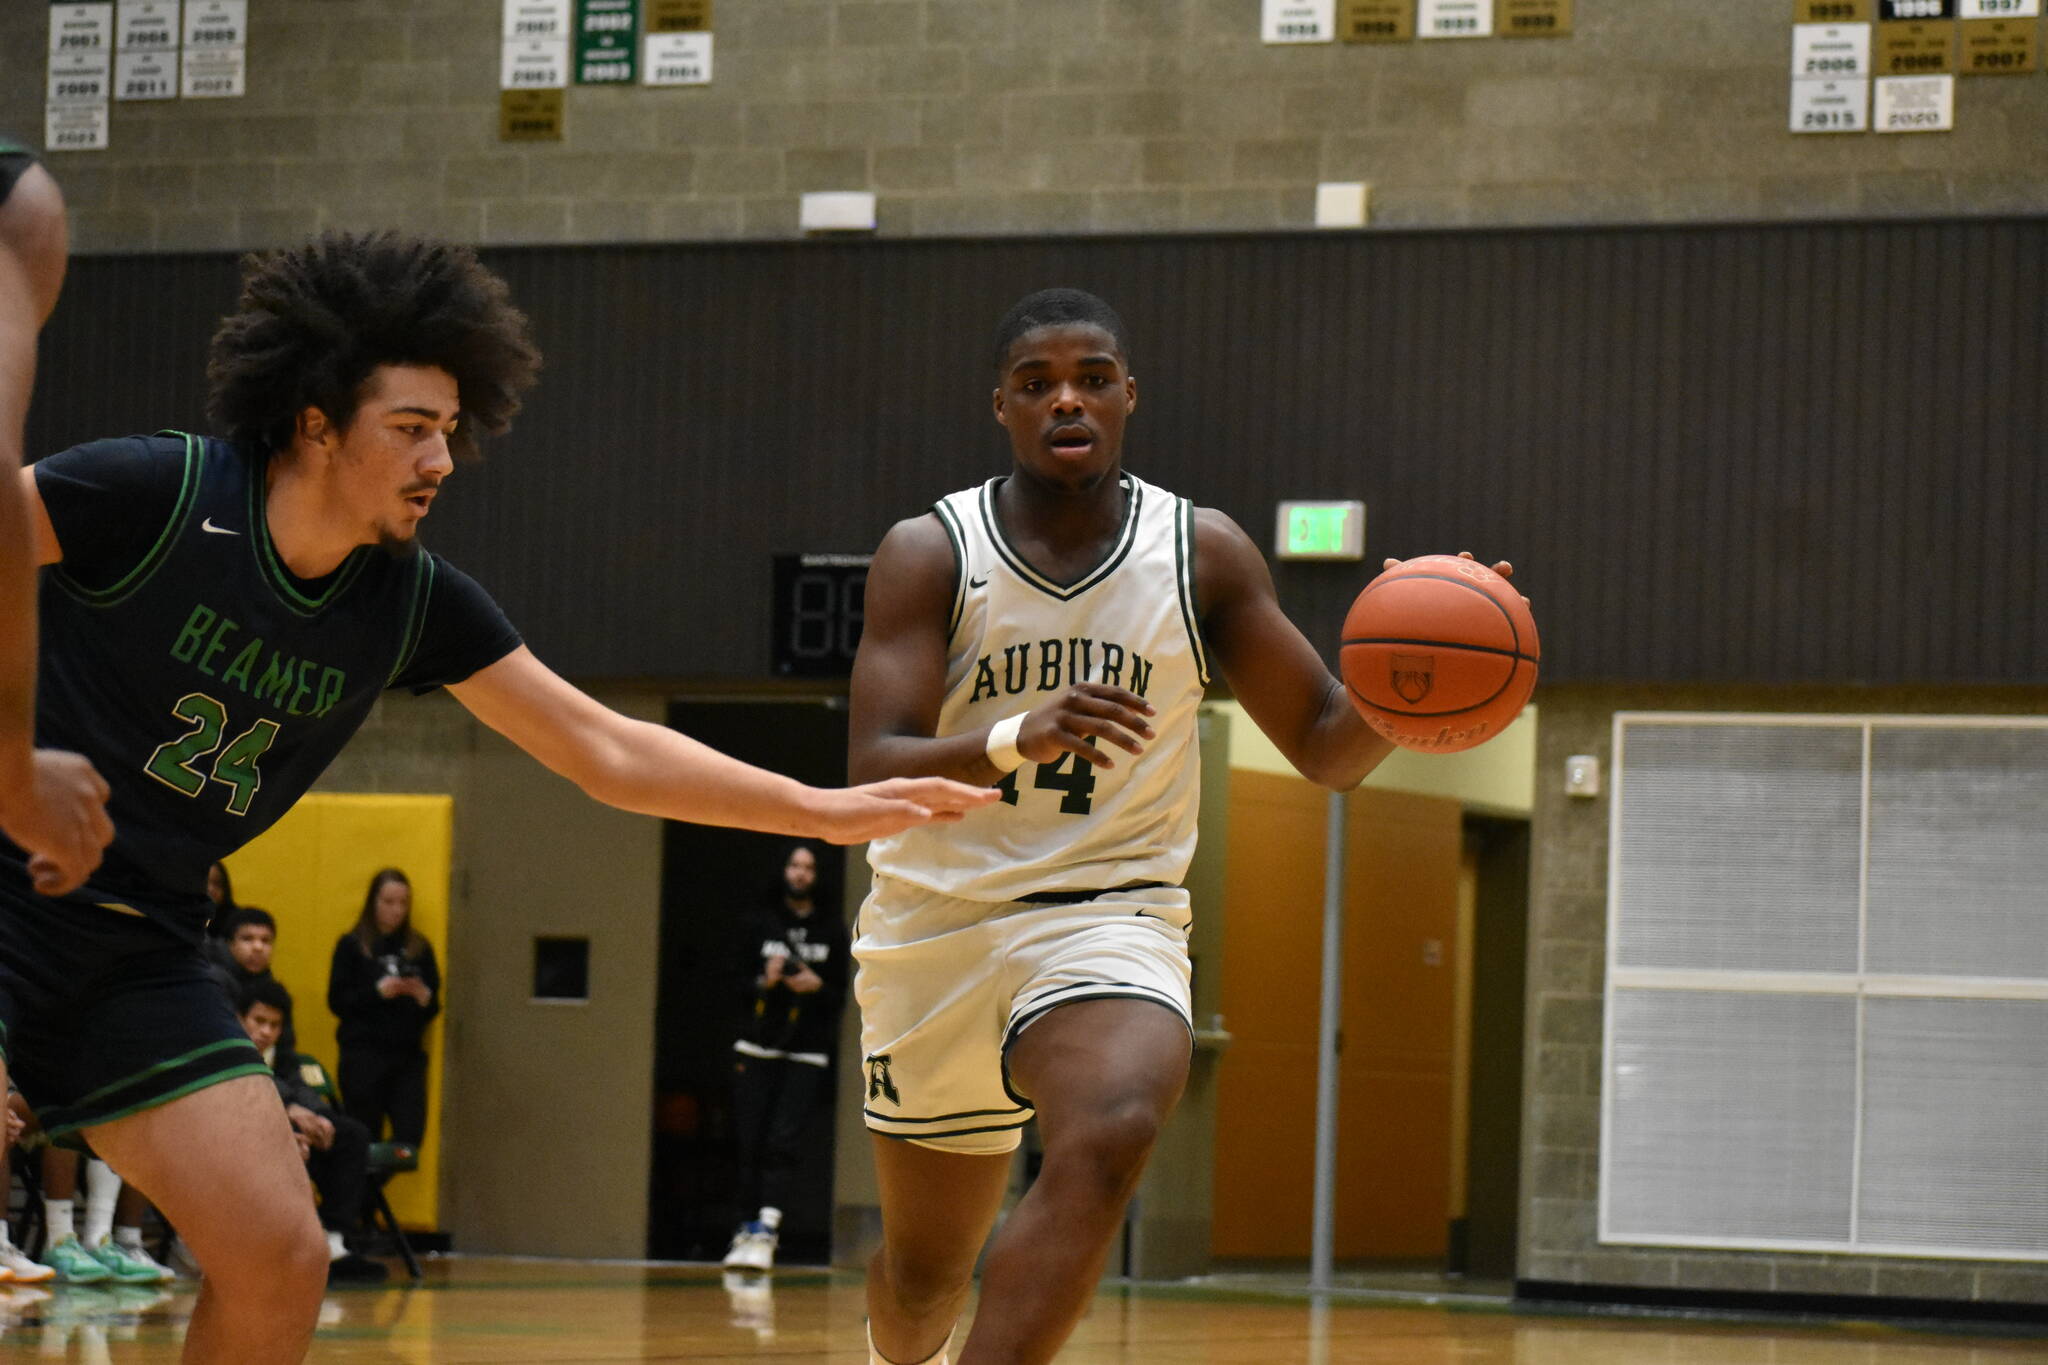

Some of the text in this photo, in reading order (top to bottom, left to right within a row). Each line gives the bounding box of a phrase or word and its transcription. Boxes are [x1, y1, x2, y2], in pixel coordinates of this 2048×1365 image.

[1973, 52, 2026, 68] 2007
[126, 81, 166, 96] 2011
[1804, 112, 1854, 128] 2015
[1888, 112, 1939, 127] 2020
[169, 603, 346, 719] BEAMER
[969, 637, 1153, 704] AUBURN
[143, 692, 281, 817] 24
